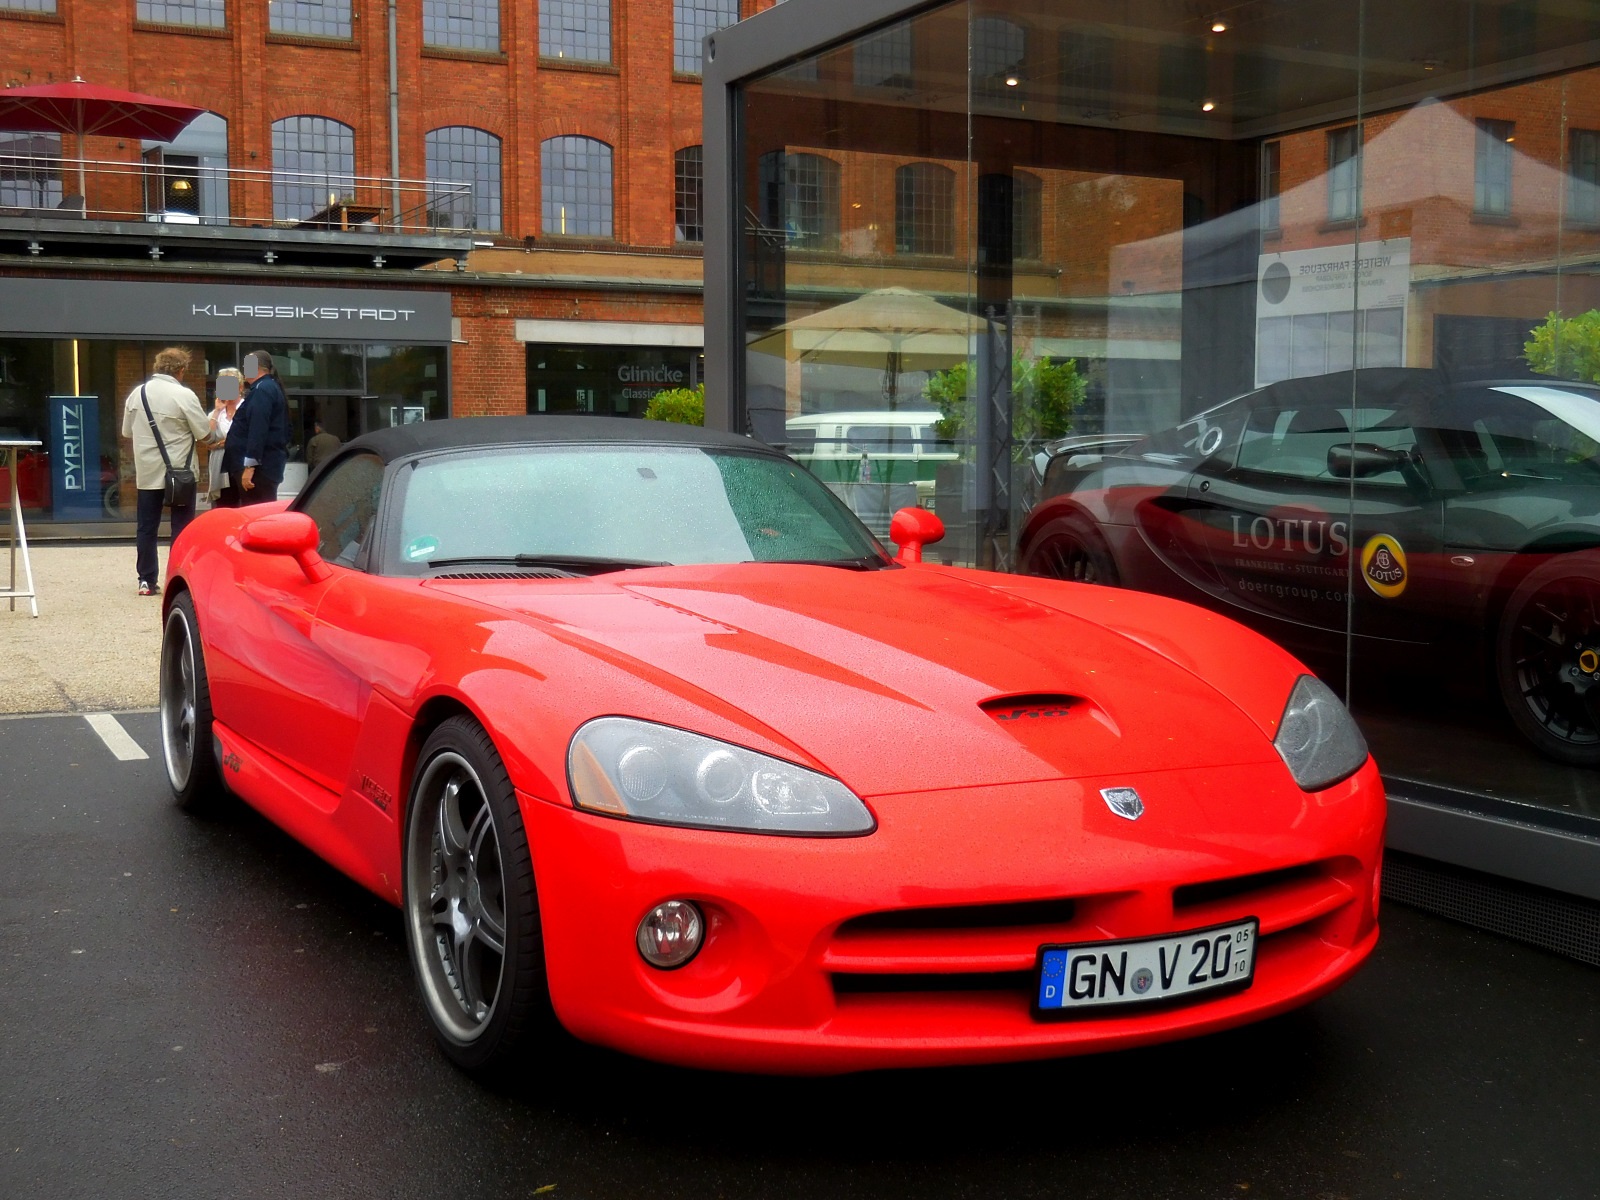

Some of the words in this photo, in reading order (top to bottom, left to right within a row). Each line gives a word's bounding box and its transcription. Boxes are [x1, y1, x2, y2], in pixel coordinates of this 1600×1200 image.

[192, 304, 415, 321] KLASSIKSTADT
[617, 364, 684, 383] Glinicke
[621, 388, 656, 399] Classic
[62, 404, 82, 490] PYRITZ
[1230, 515, 1348, 556] LOTUS
[1234, 558, 1285, 571] FRANKFURT
[1368, 566, 1403, 582] LOTUS
[1236, 929, 1249, 943] 05
[1068, 951, 1129, 1000] GN
[1158, 943, 1182, 990] V
[1188, 934, 1232, 985] 20
[1234, 959, 1246, 974] 10
[1045, 984, 1056, 998] D
